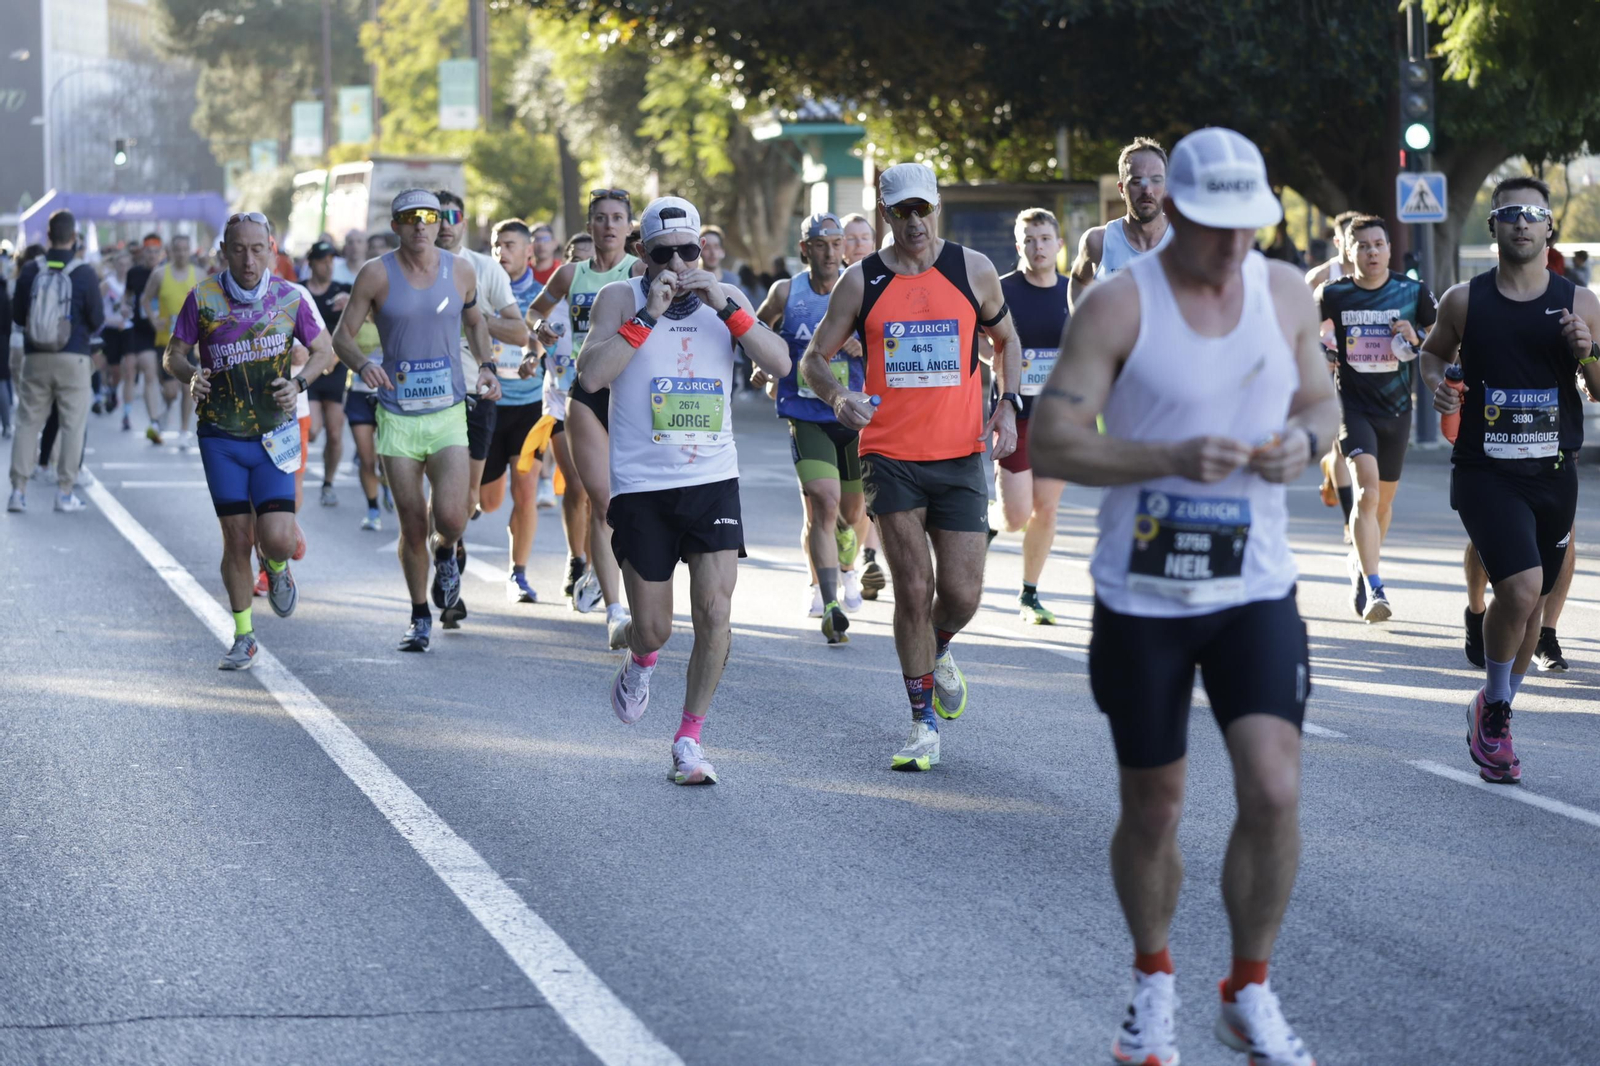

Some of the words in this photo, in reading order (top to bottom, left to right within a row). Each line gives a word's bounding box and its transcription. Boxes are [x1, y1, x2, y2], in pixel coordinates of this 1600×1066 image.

[909, 323, 950, 334] ZURICH
[220, 339, 251, 357] GRAN
[253, 332, 287, 349] FONDO
[911, 343, 933, 353] 4645
[414, 360, 445, 370] ZURICH
[886, 361, 924, 372] MIGUEL
[927, 358, 960, 371] ÁNGEL
[404, 385, 446, 398] DAMIAN
[1511, 393, 1550, 403] ZURICH
[678, 400, 700, 410] 2674
[667, 413, 710, 428] JORGE
[1512, 413, 1534, 423] 3930
[1484, 432, 1509, 442] PACO
[1510, 431, 1559, 443] RODRÍGUEZ
[1175, 501, 1240, 520] ZURICH
[1164, 553, 1213, 579] NEIL
